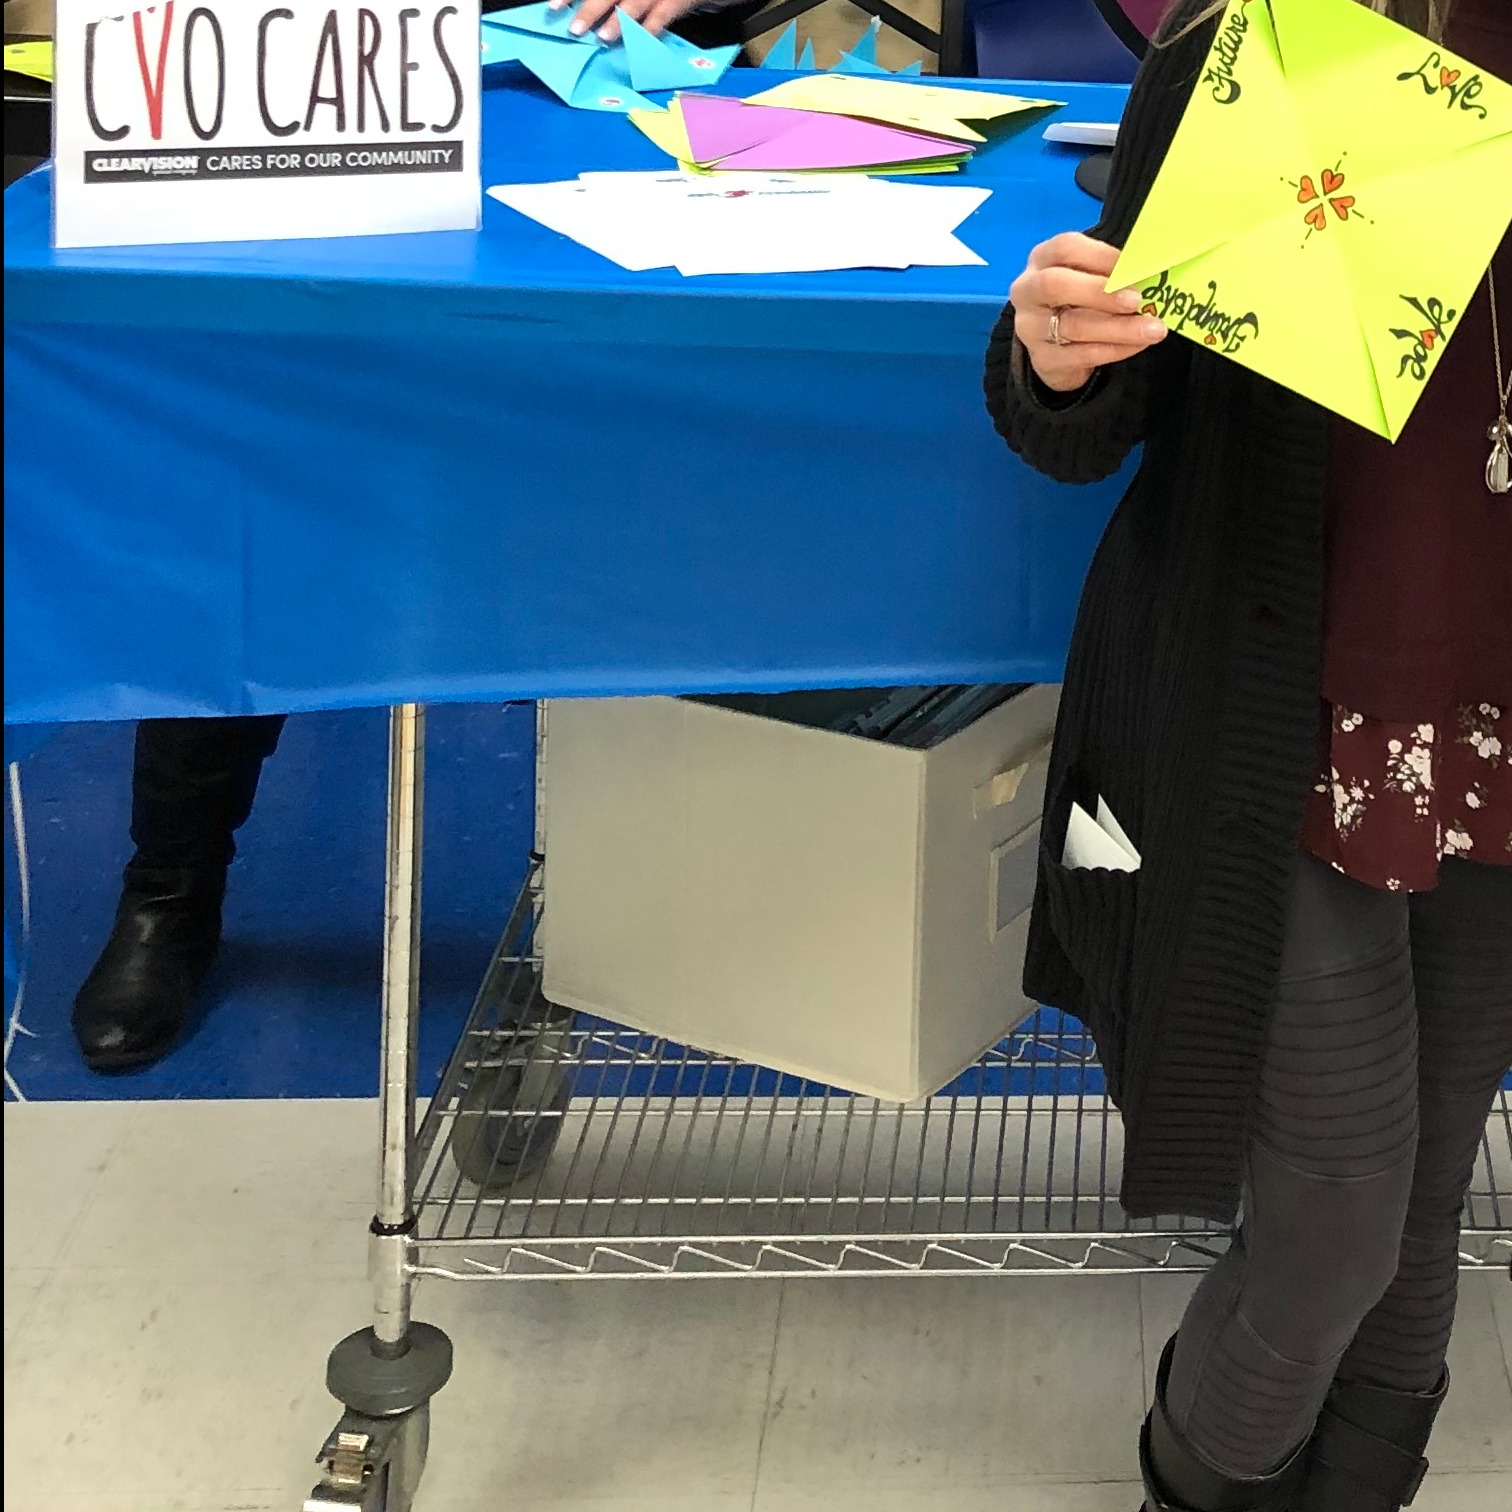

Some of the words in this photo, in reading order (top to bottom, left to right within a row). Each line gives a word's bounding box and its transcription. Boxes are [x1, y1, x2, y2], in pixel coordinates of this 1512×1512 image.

[84, 0, 226, 141] CVO
[256, 6, 464, 137] CARES
[91, 156, 201, 174] CLEARVISION
[206, 155, 263, 171] CARES
[266, 153, 301, 169] FOR
[304, 152, 342, 168] OUR
[345, 149, 454, 167] COMMUNITY
